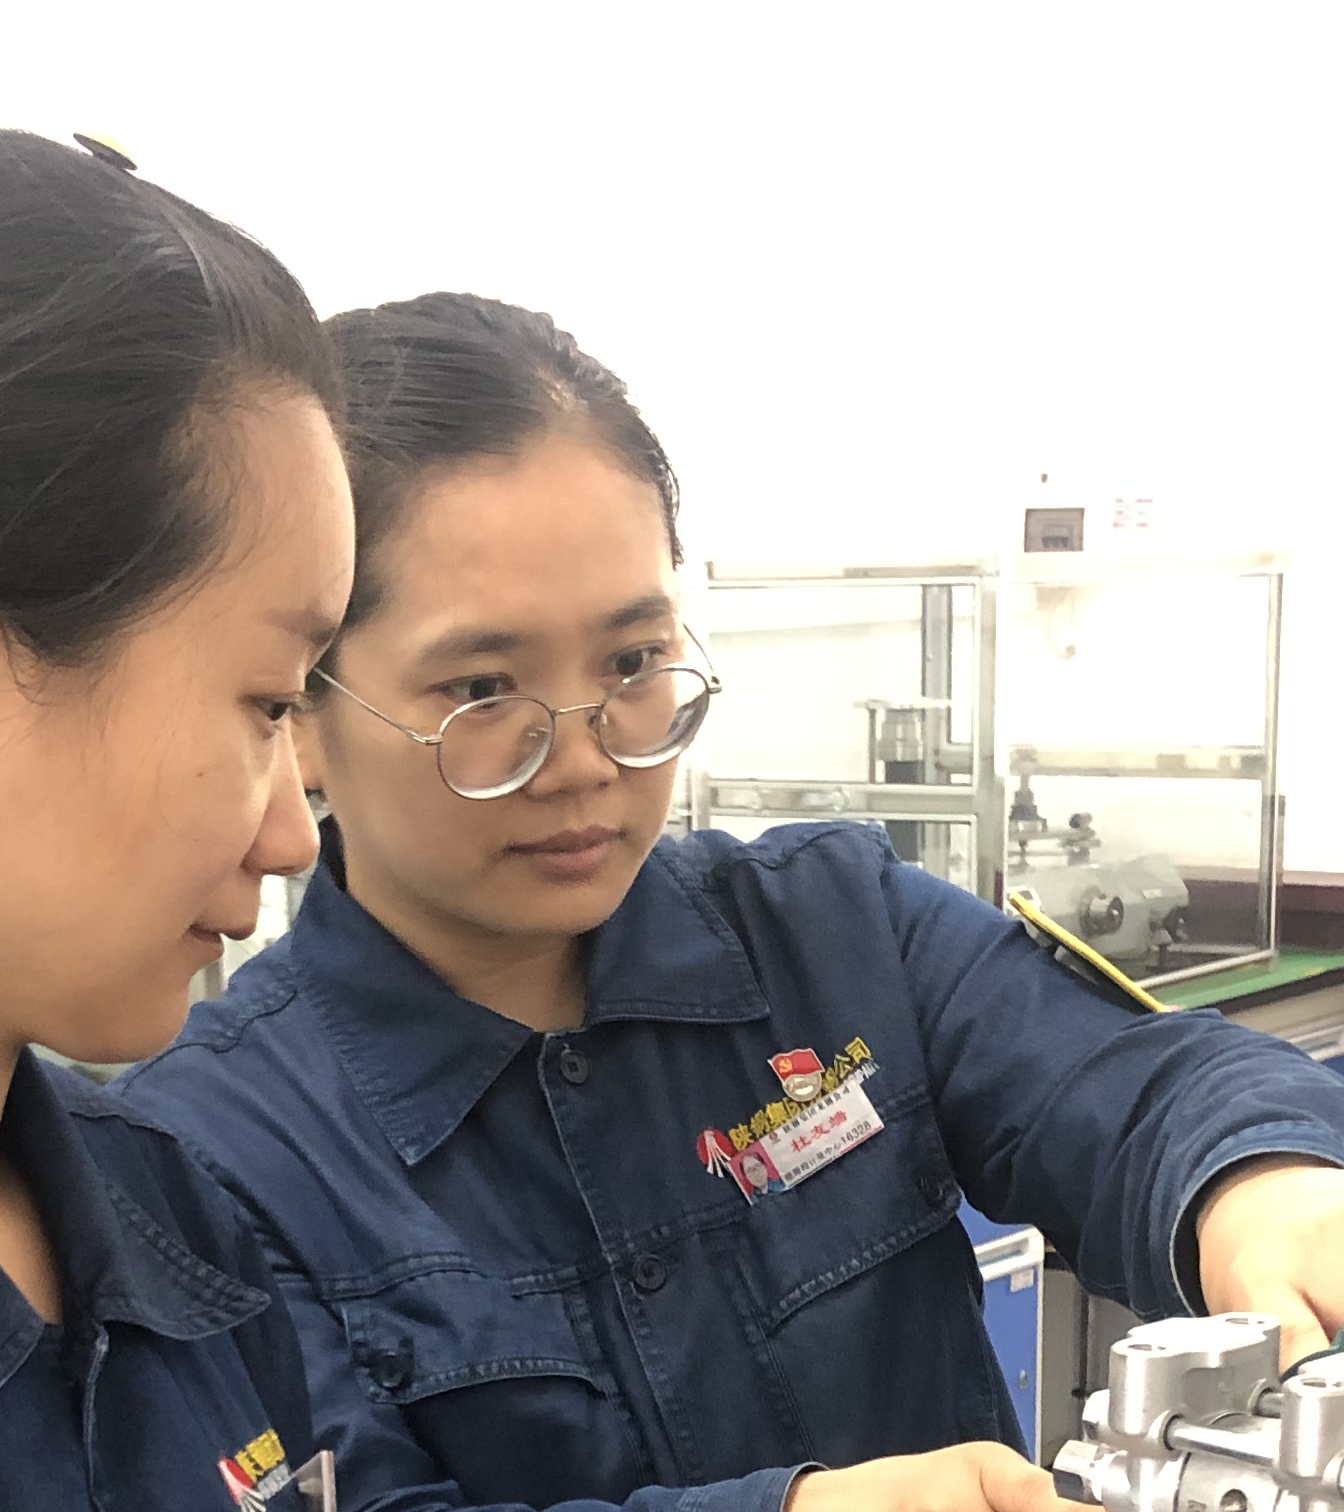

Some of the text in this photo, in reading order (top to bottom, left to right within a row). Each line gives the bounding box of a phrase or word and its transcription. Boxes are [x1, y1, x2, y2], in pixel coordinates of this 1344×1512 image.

[727, 1036, 873, 1151] 陕钢集团钢公司
[841, 1120, 873, 1147] 16328
